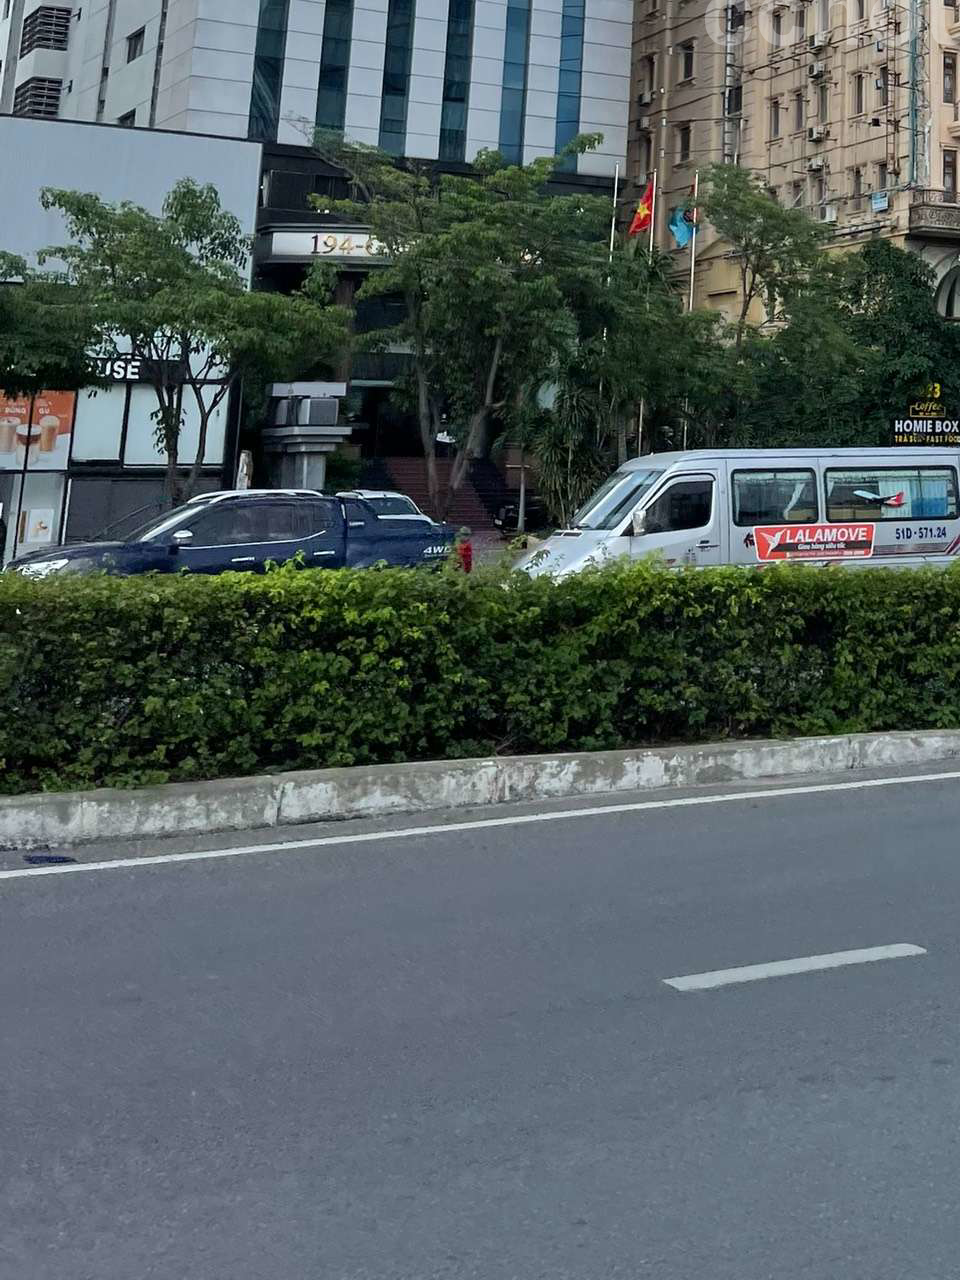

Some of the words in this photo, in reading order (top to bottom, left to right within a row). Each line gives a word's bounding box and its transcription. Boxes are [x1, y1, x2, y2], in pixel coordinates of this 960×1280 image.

[895, 420, 933, 432] HOMIE
[935, 420, 959, 433] BOX
[786, 527, 868, 543] LALAMOVE
